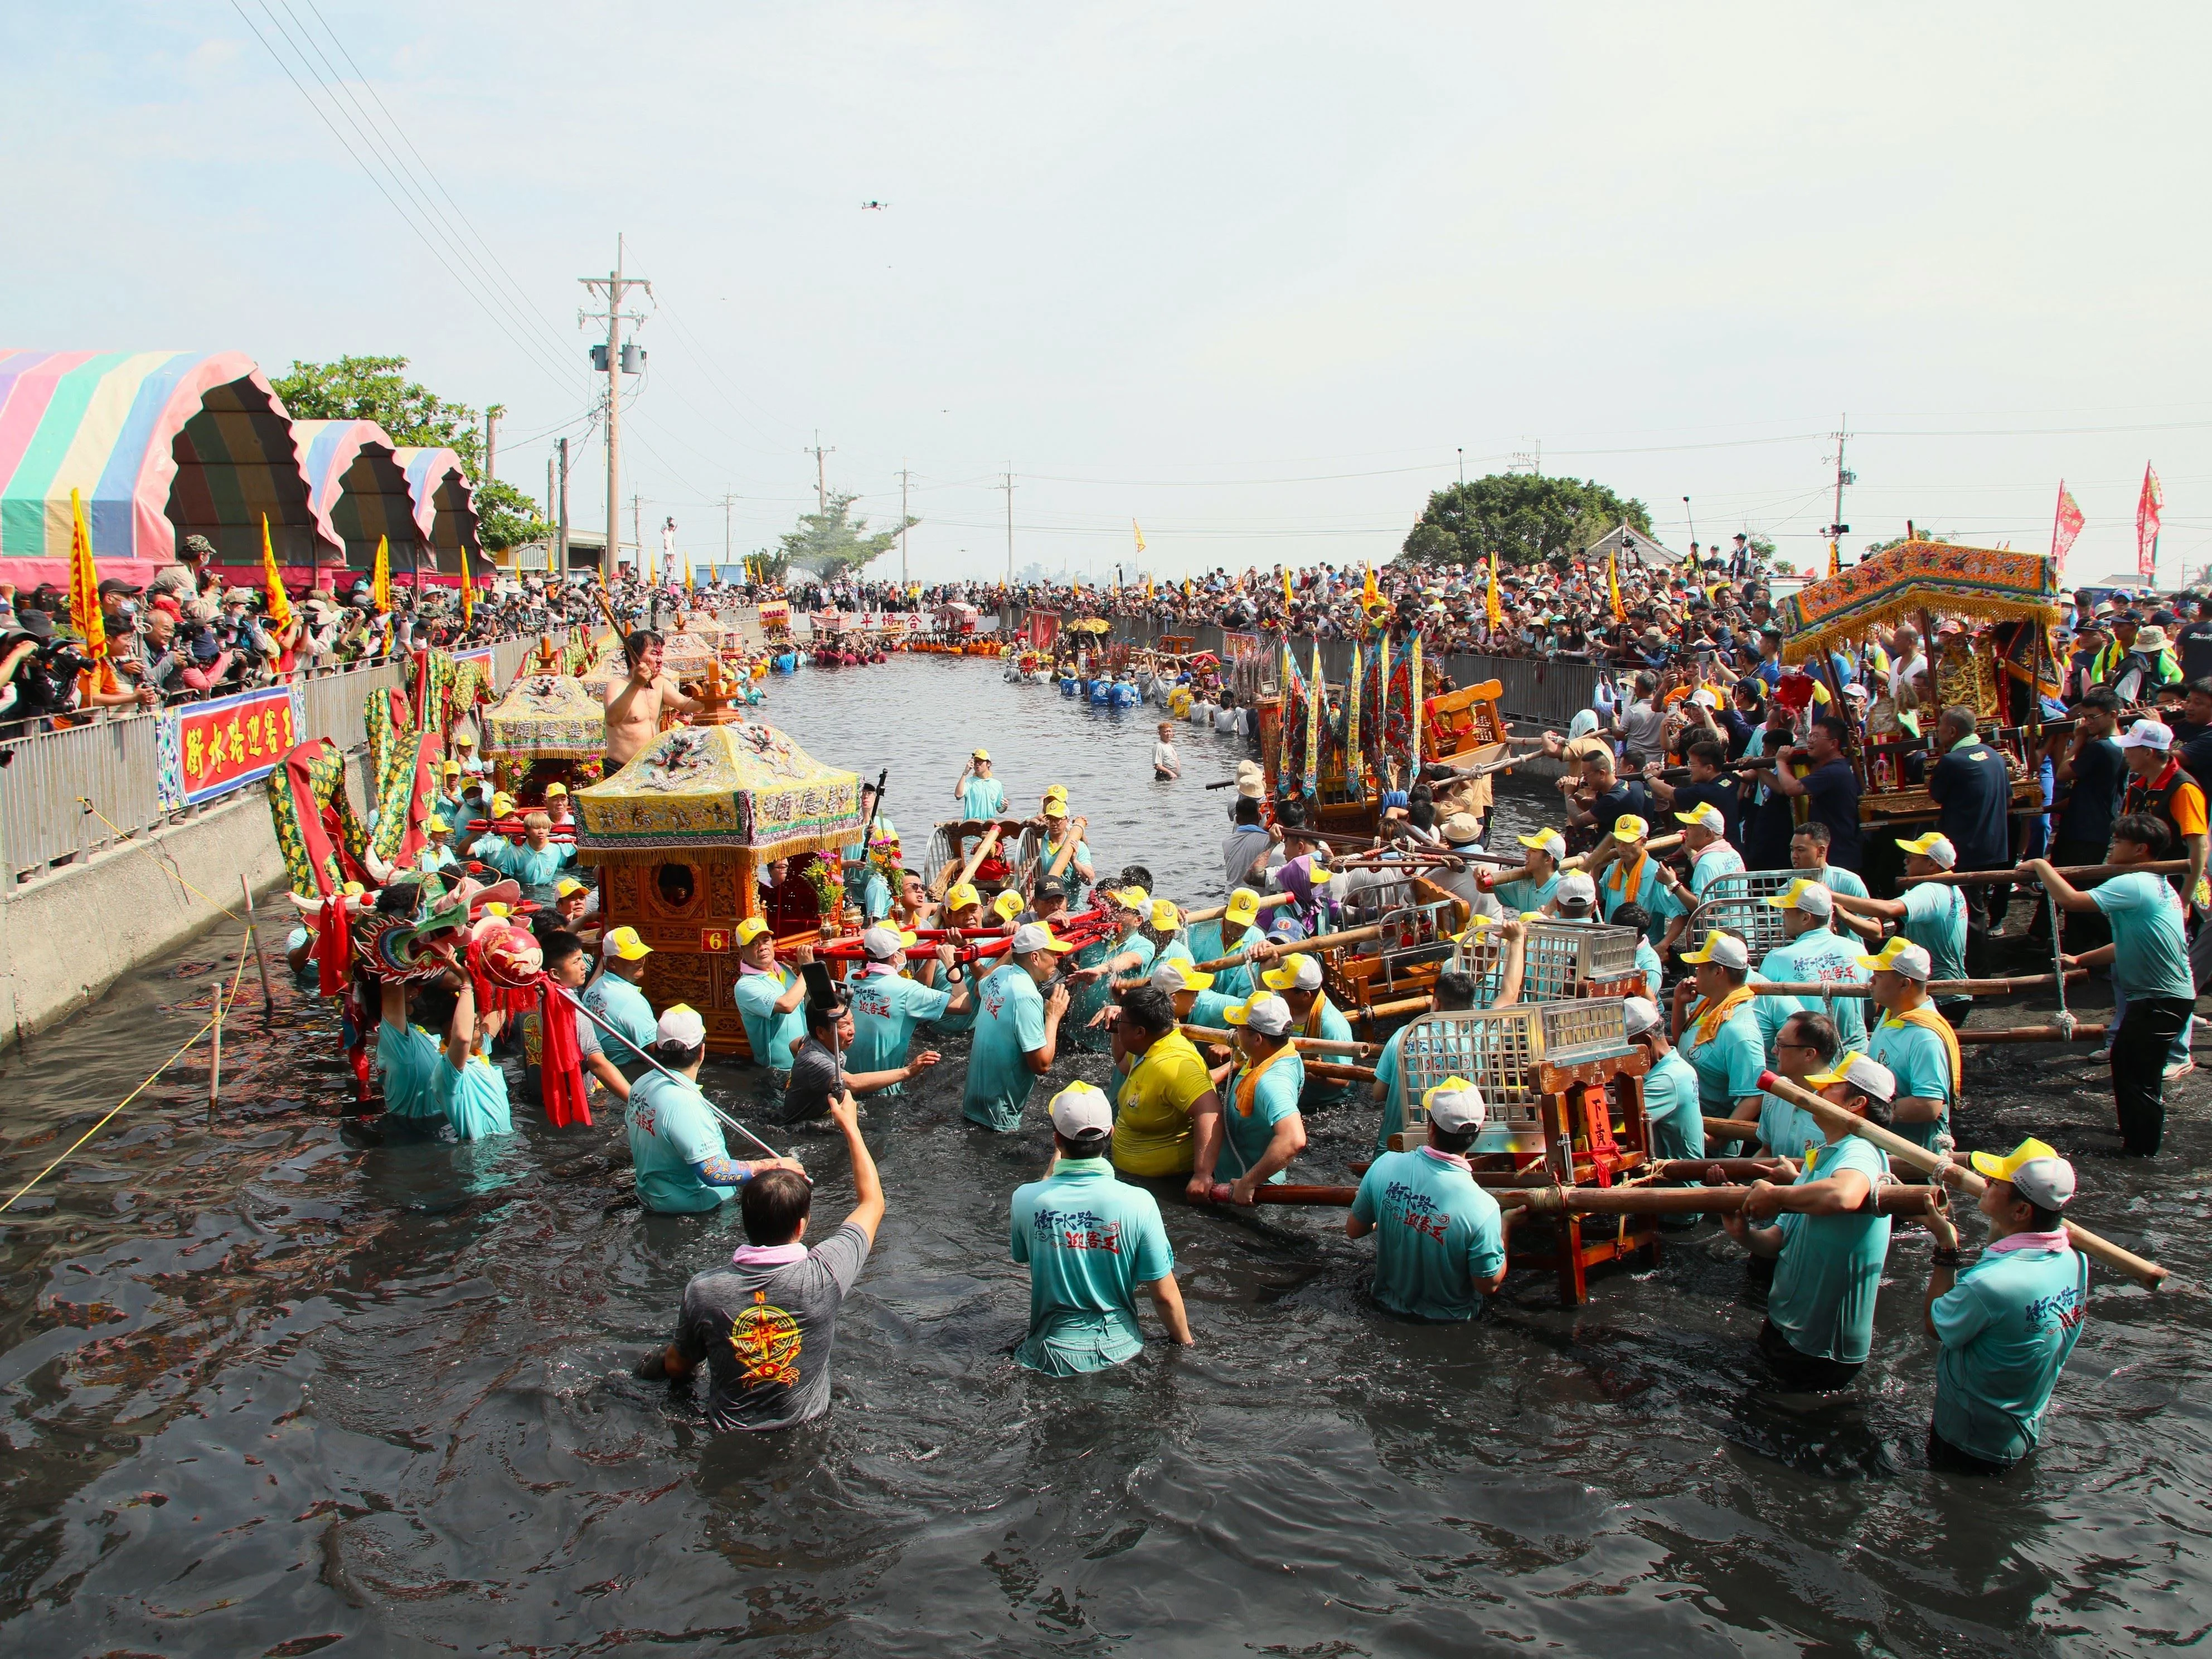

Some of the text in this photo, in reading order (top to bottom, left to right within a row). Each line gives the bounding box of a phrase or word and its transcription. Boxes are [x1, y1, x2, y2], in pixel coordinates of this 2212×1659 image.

[710, 933, 721, 949] 6
[1794, 953, 1843, 971] 衝水路
[1818, 964, 1857, 981] 迎客王
[859, 1000, 890, 1018] 迎客王
[1385, 1181, 1439, 1213] 衝水路
[1034, 1209, 1104, 1230] 衝水路
[1403, 1208, 1448, 1246] 迎客王
[1065, 1231, 1119, 1254] 迎客王
[755, 1291, 766, 1302] N
[2026, 1286, 2079, 1321] 衝水路
[765, 1366, 774, 1376] S
